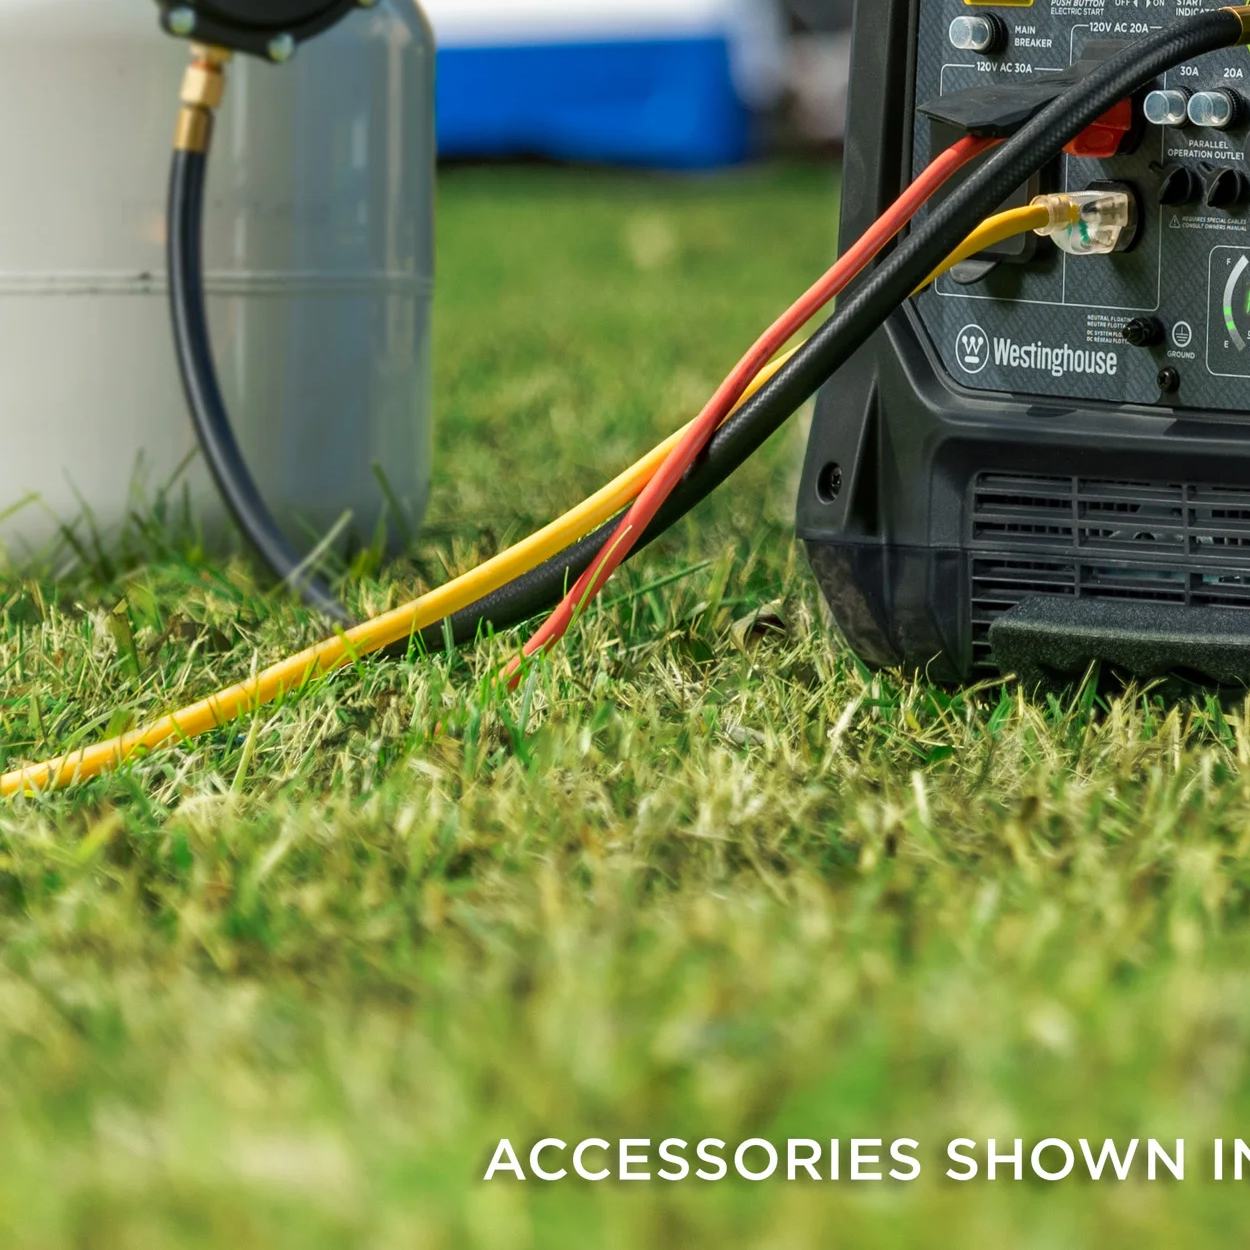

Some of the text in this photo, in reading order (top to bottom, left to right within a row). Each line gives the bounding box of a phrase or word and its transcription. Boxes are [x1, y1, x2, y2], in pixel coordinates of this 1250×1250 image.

[1051, 0, 1105, 8] PUSH BUTTON
[1153, 0, 1165, 7] ON
[1051, 8, 1104, 16] ELECTRIC START
[1015, 26, 1036, 35] MAIN
[1090, 22, 1149, 33] 120V AC 20A
[1015, 38, 1052, 48] BREAKER
[977, 62, 1033, 73] 120V AC 30A
[1180, 66, 1199, 77] 30A
[1223, 68, 1244, 78] 20A
[1188, 139, 1229, 149] PARALLEL
[1167, 149, 1213, 159] OPERATION
[993, 337, 1117, 377] Westinghouse
[1167, 350, 1196, 359] GROUND
